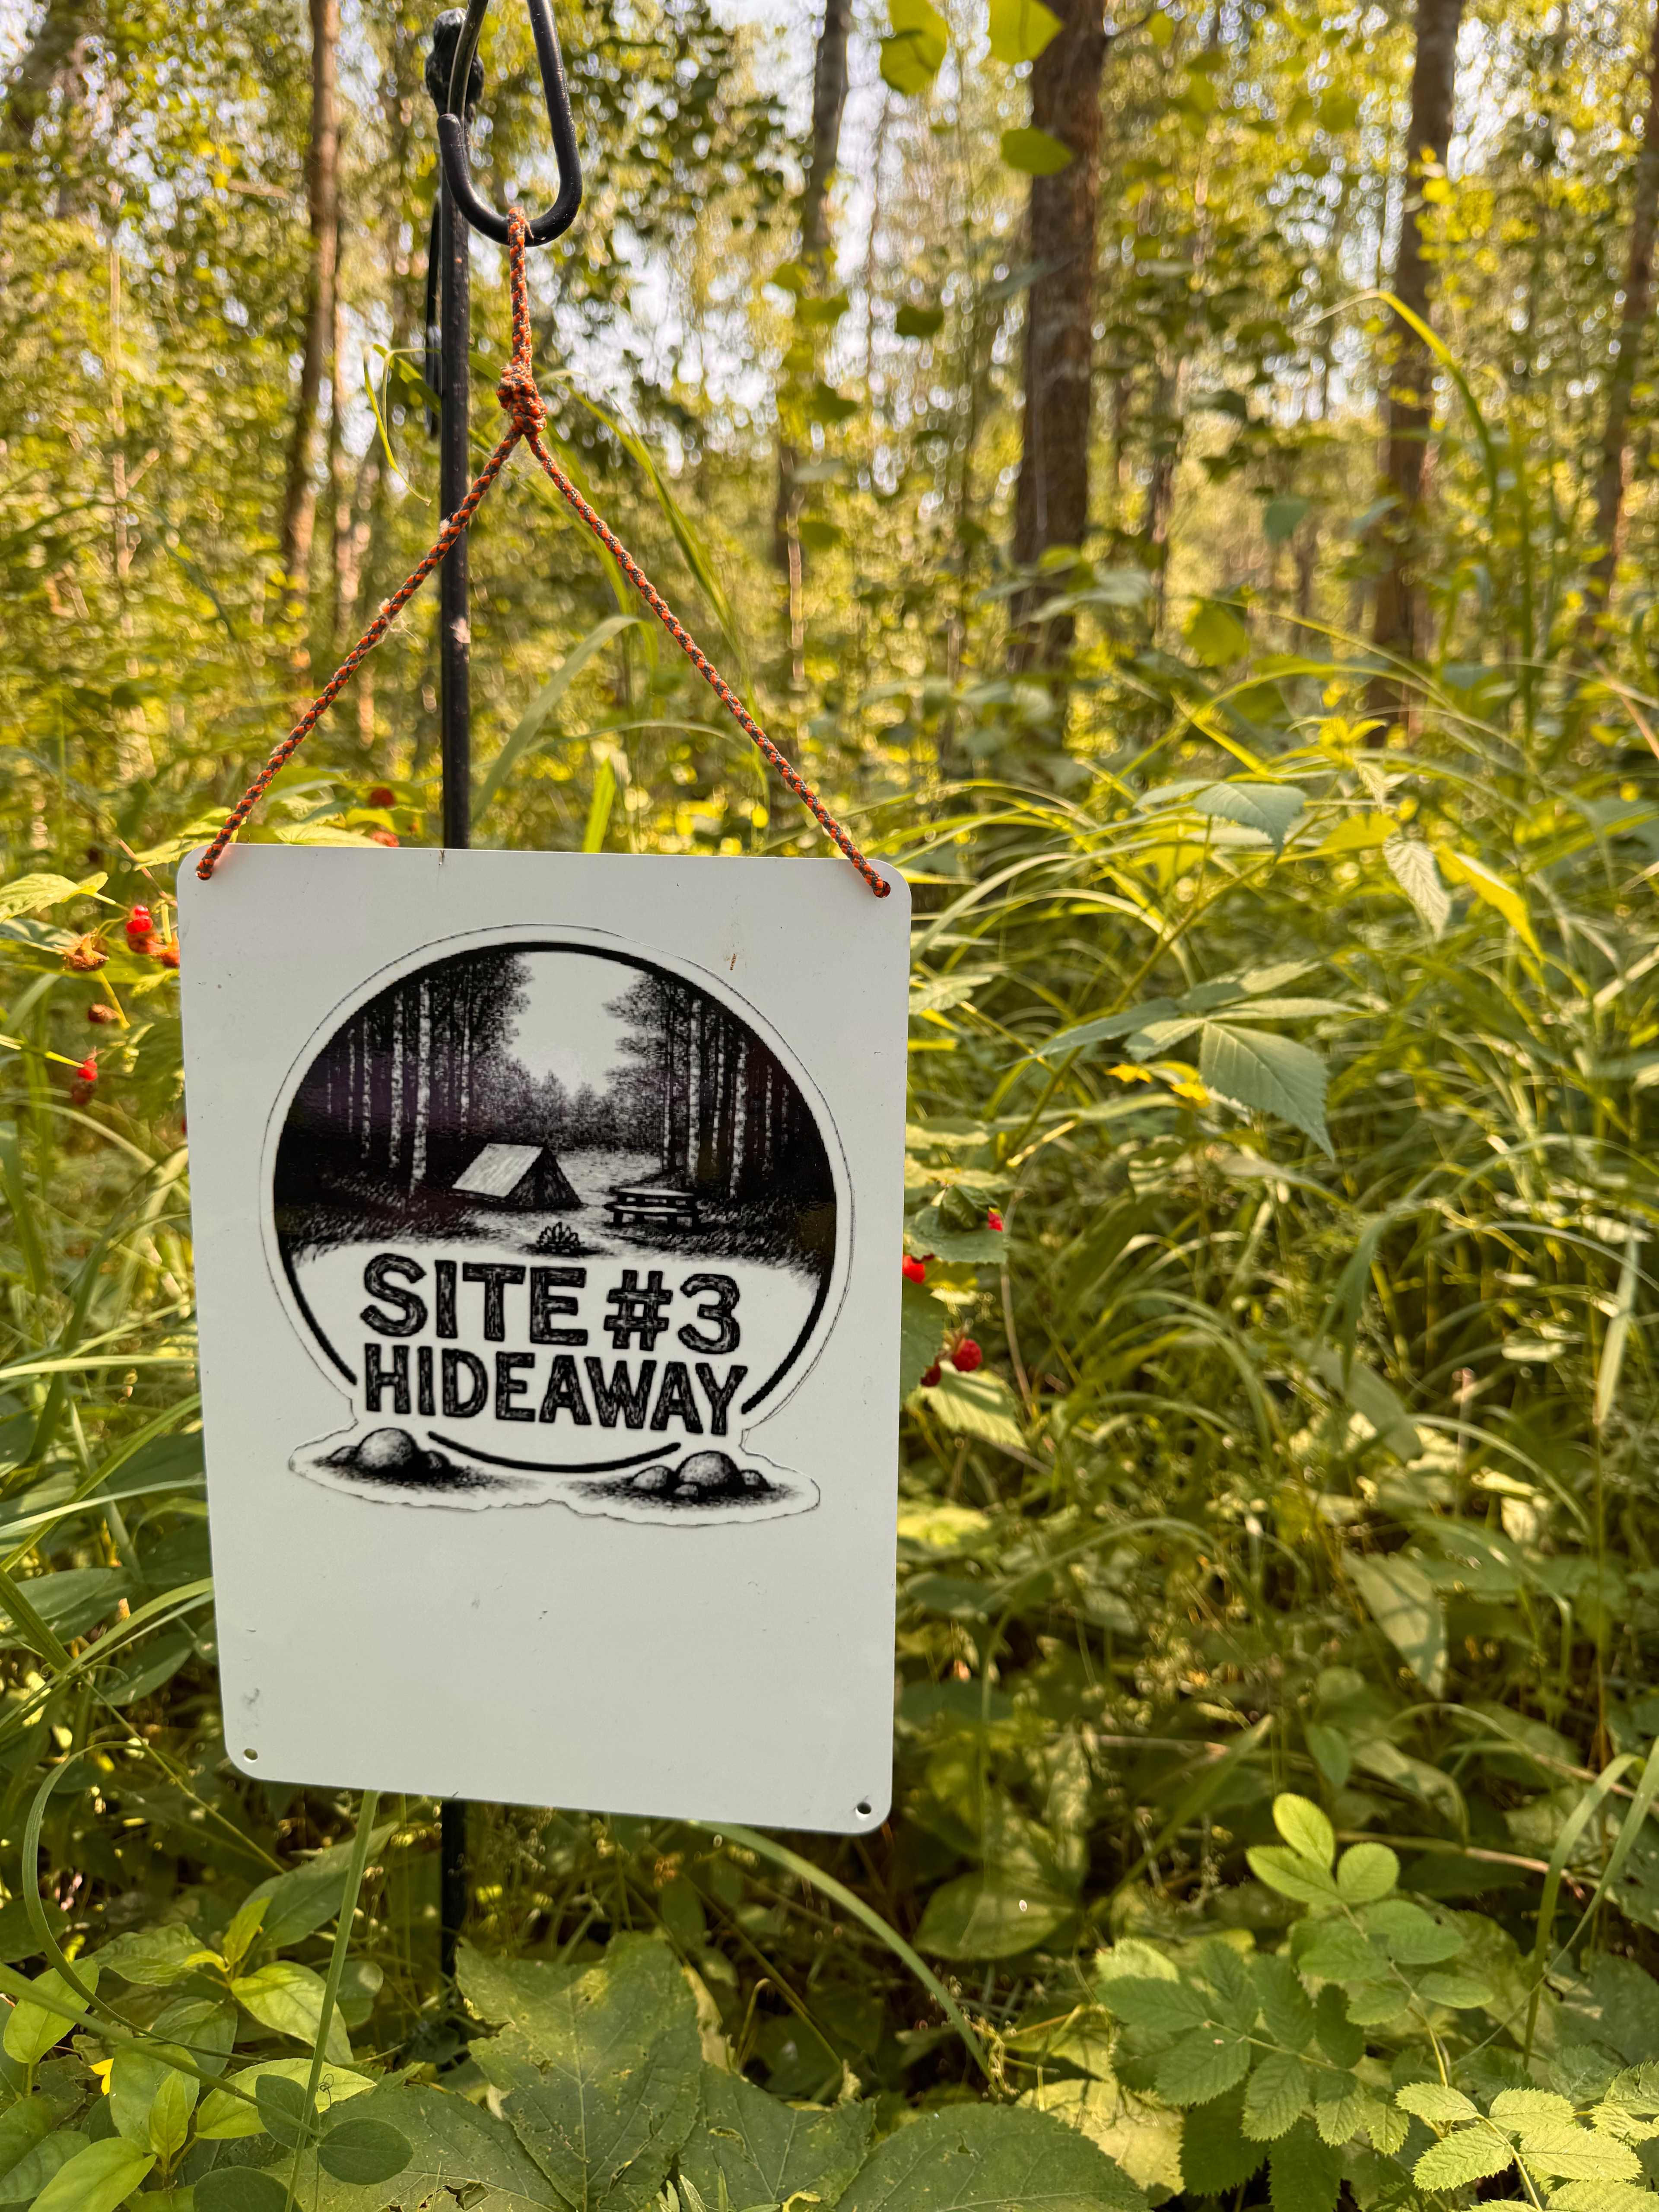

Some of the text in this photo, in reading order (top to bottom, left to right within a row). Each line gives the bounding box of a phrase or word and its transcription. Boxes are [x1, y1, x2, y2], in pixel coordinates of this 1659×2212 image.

[360, 1253, 741, 1355] SITE #3
[364, 1343, 748, 1437] HIDEAWAY
